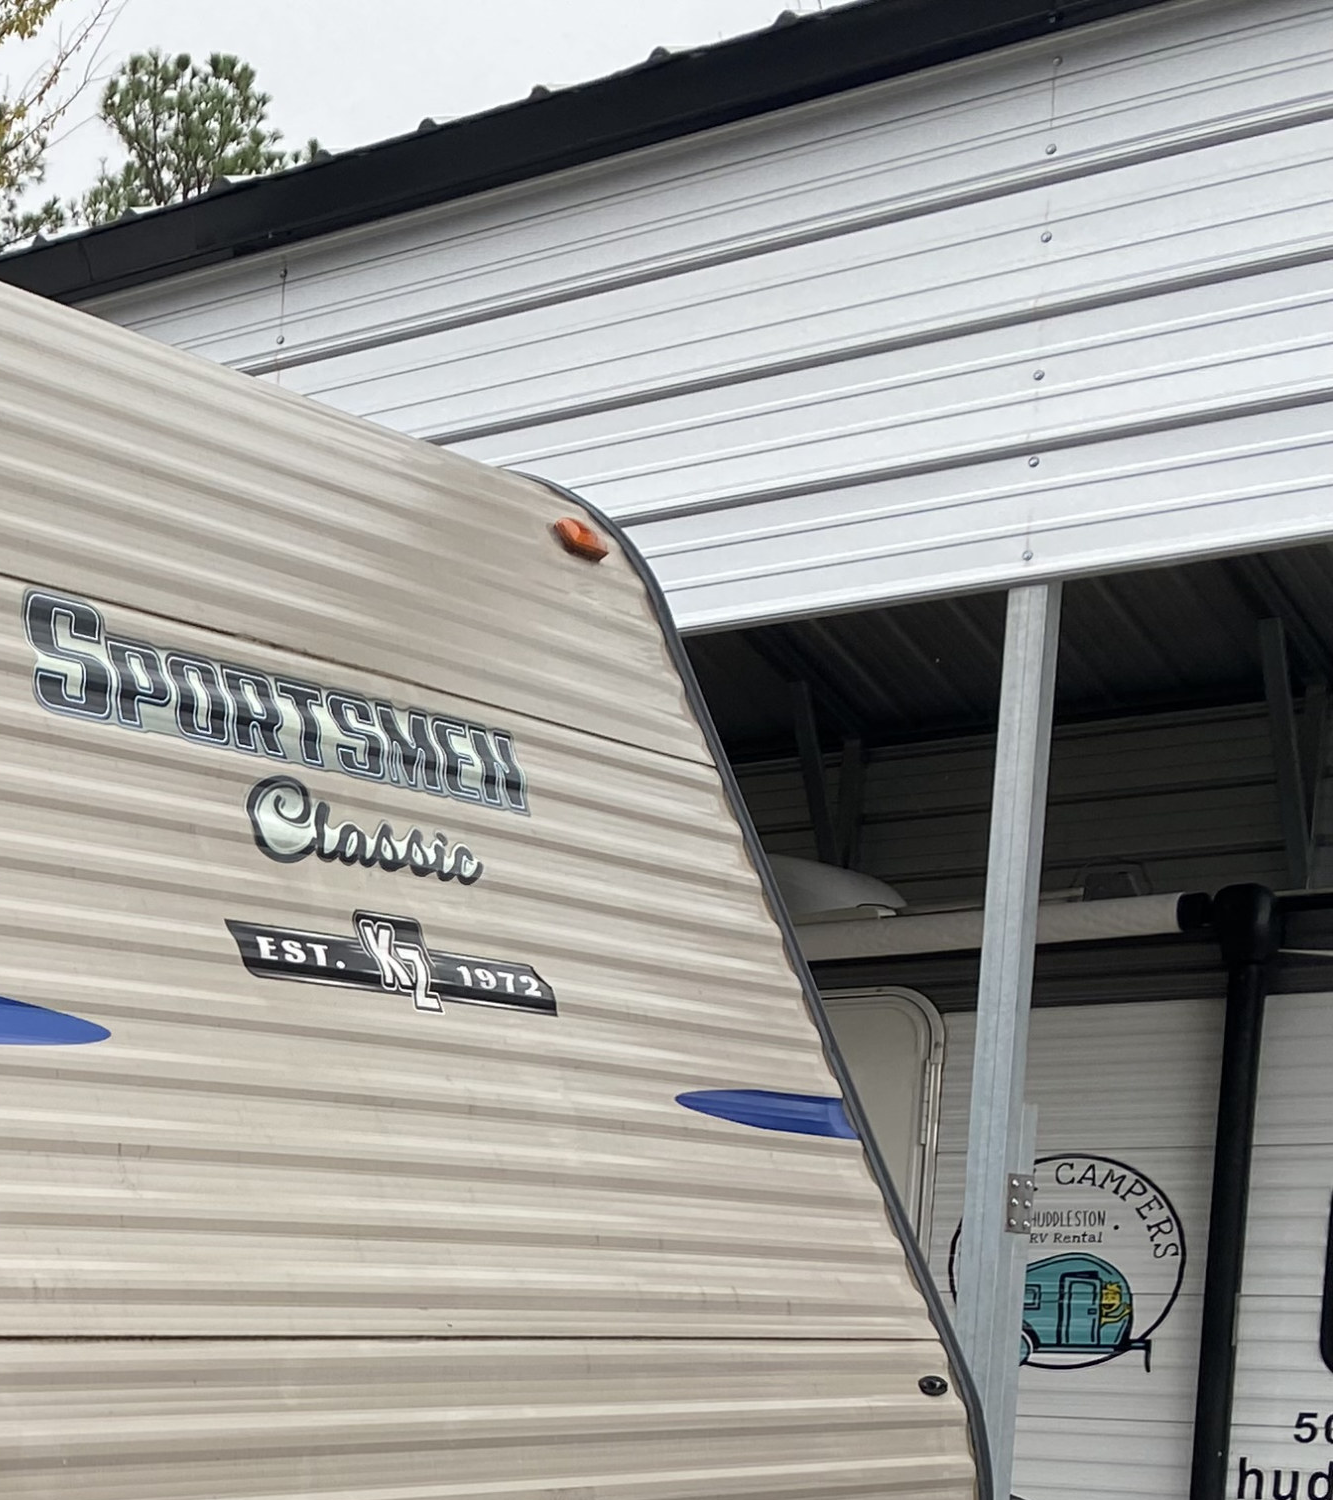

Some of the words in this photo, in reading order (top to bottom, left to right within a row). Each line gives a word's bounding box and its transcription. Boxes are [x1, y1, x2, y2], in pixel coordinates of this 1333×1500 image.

[23, 588, 531, 817] SPORTSMEN
[246, 775, 484, 886] Classic
[255, 935, 347, 970] EST.
[455, 964, 544, 998] 1972
[1028, 1232, 1049, 1244] RV
[1052, 1231, 1103, 1244] Rental
[1054, 1161, 1180, 1260] CAMPERS
